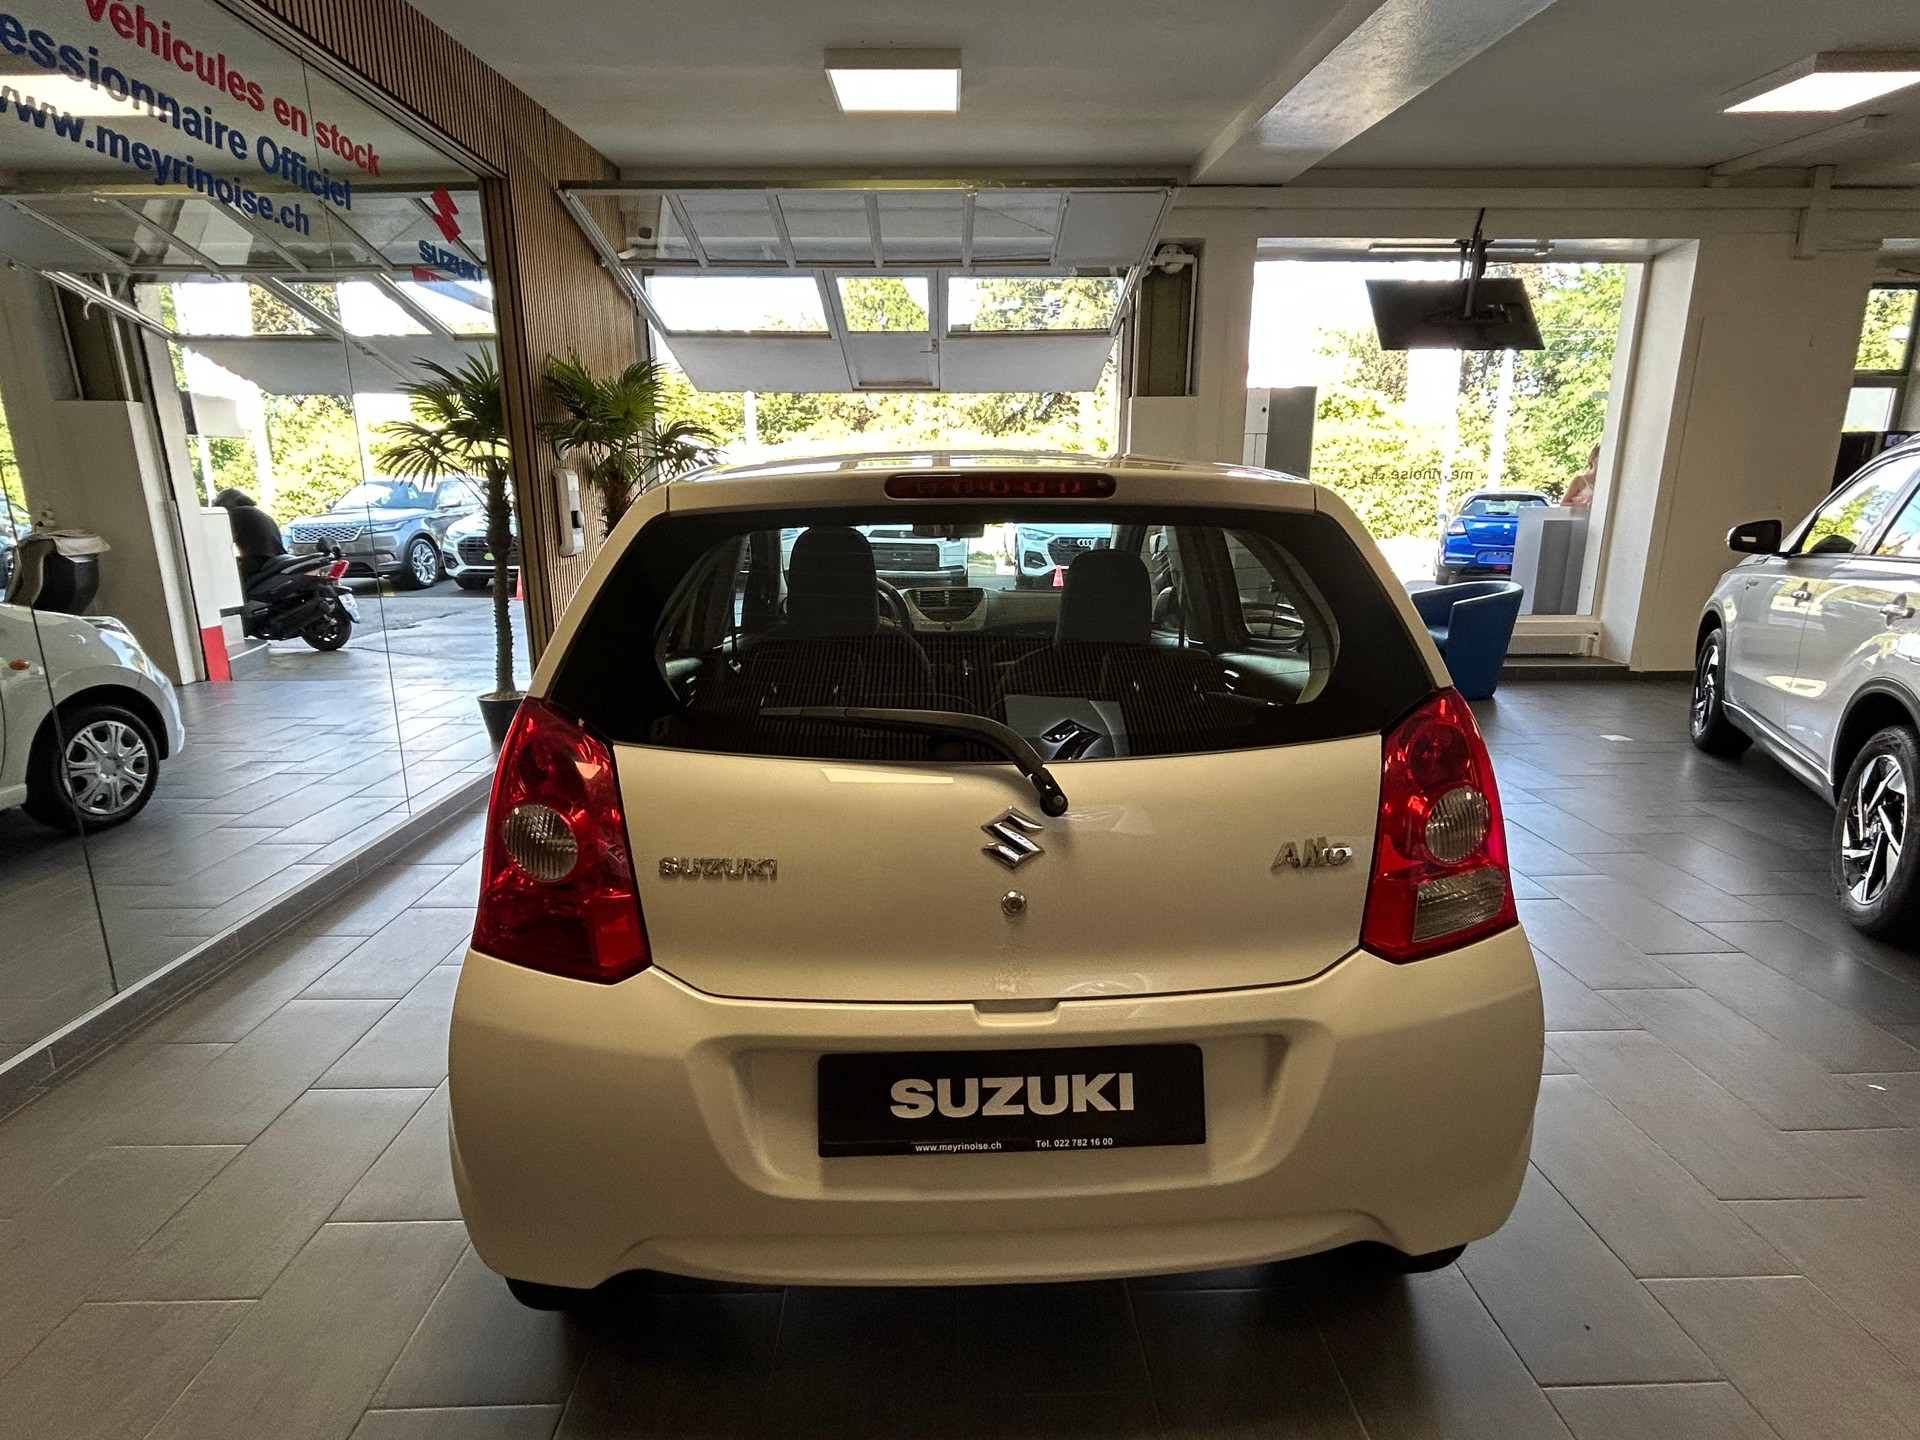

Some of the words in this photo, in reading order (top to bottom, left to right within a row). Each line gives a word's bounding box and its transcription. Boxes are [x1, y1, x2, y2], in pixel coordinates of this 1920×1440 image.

[273, 97, 307, 137] en
[316, 121, 380, 177] stock
[0, 85, 309, 236] ww.meyrinoise.ch
[257, 136, 351, 210] Officiel
[419, 240, 482, 283] SUZUKI
[659, 857, 778, 880] SUZUKI
[1271, 836, 1353, 872] Alto
[890, 1072, 1135, 1119] SUZUKI
[915, 1141, 1002, 1152] www.meyrinoise.ch
[1054, 1139, 1070, 1148] 022
[1072, 1138, 1087, 1147] 782
[1090, 1138, 1100, 1147] 16
[1102, 1137, 1113, 1146] 00
